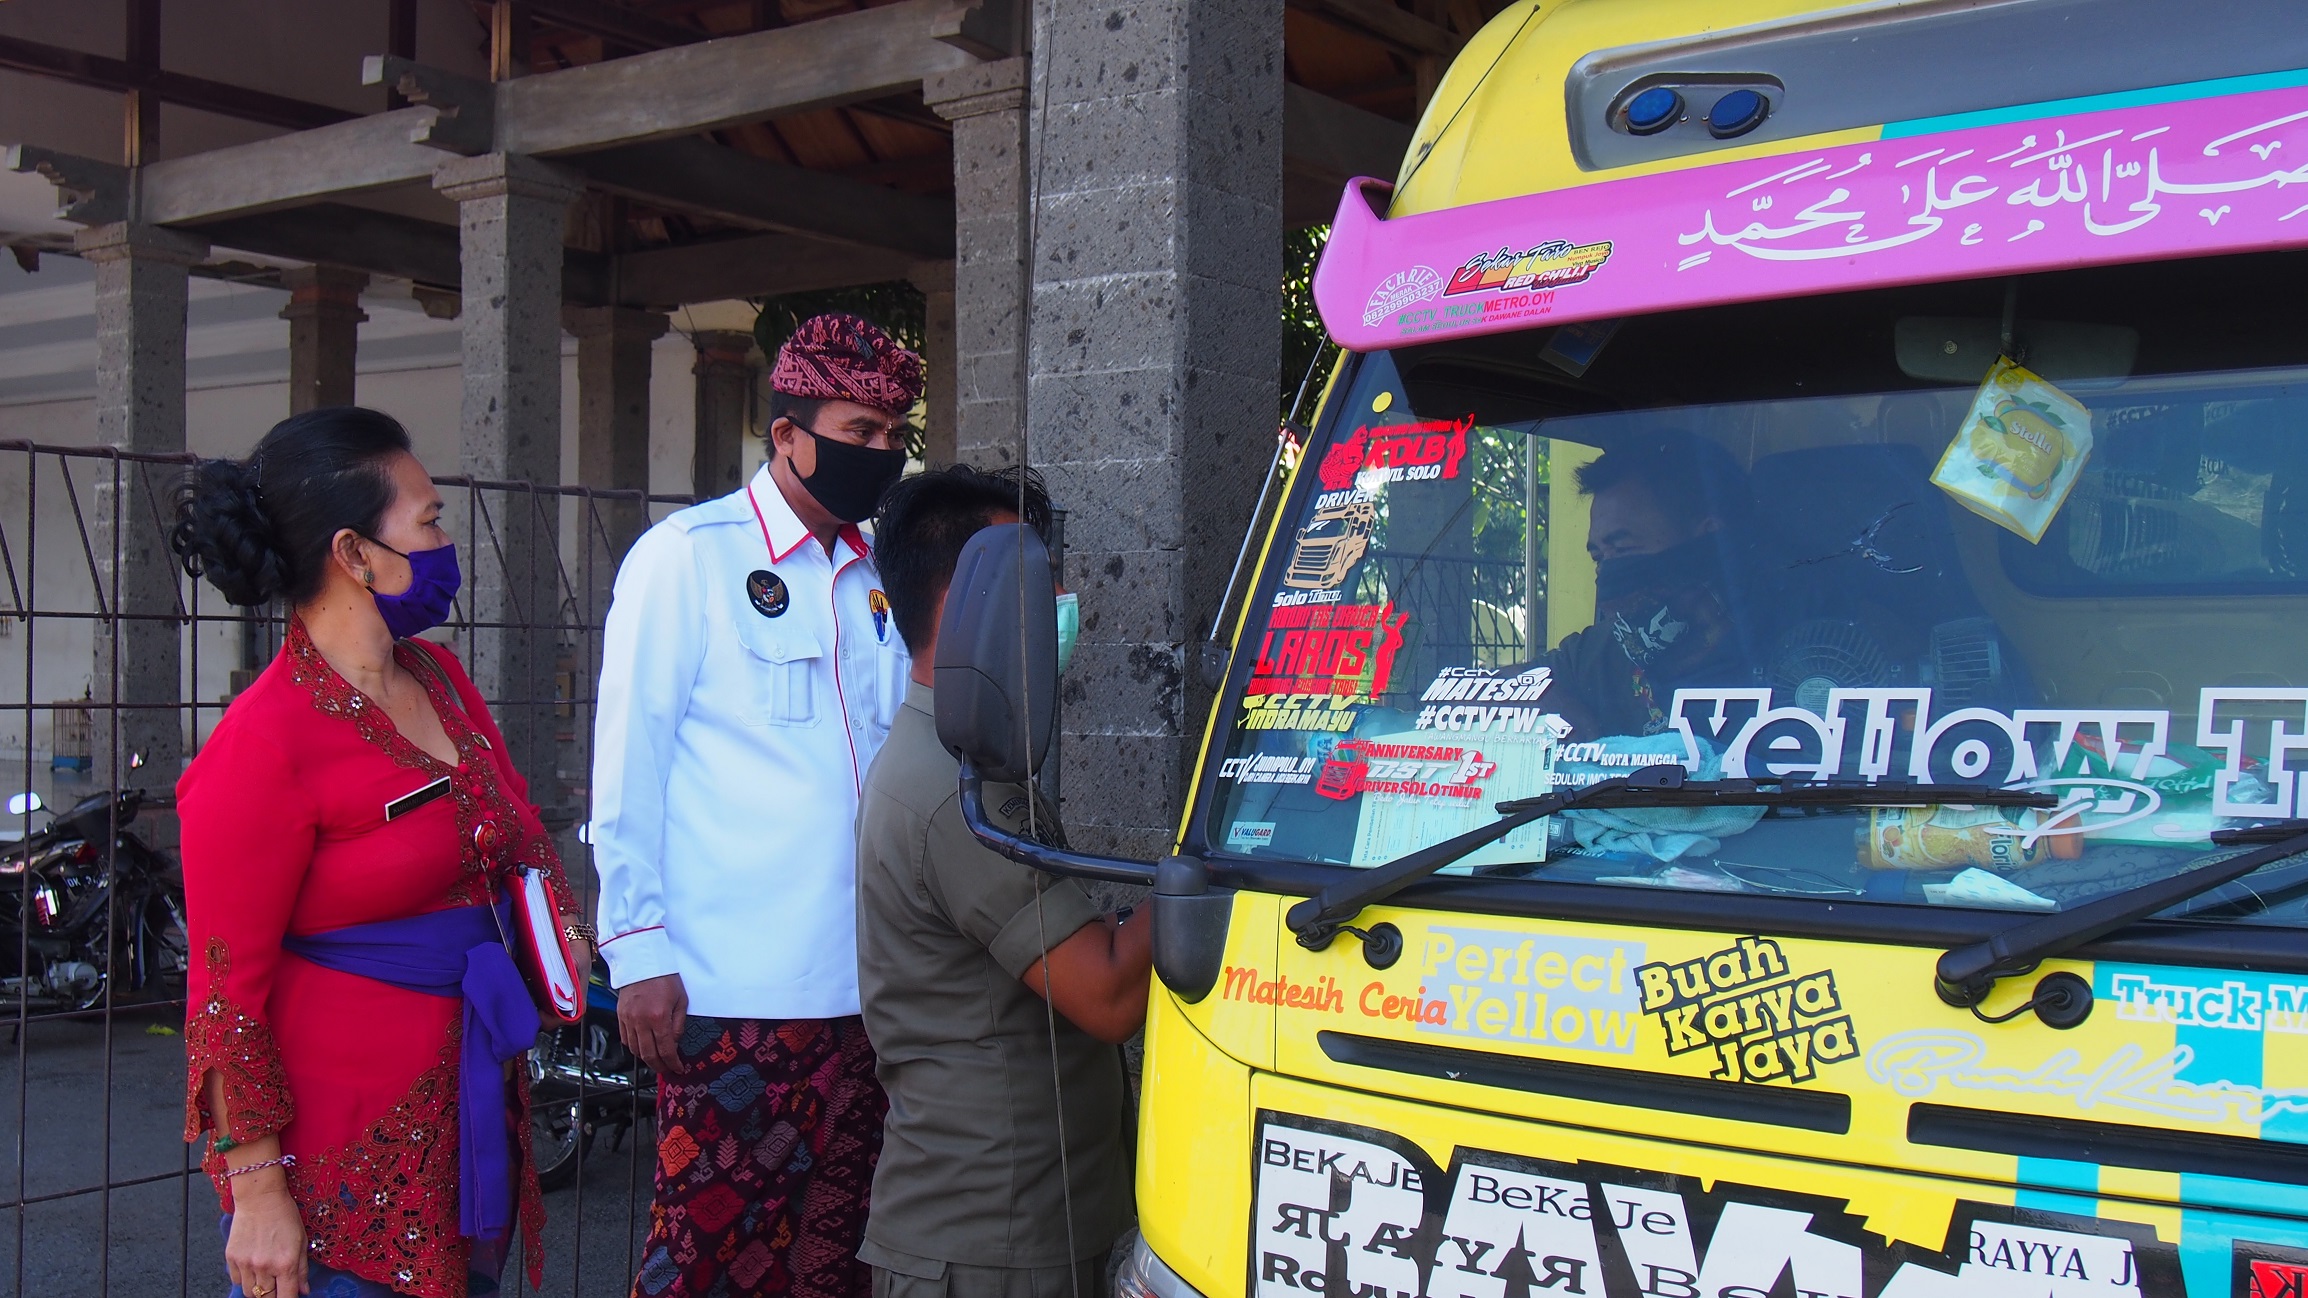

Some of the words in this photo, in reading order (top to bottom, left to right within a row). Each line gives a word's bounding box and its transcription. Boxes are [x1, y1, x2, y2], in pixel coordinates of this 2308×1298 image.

[1504, 273, 1537, 290] RED
[1537, 264, 1591, 282] CHILLI
[1398, 309, 1438, 326] #CCTV
[1488, 311, 1522, 323] DAWANE
[1523, 306, 1552, 319] DALAN
[1364, 435, 1447, 467] KDLB
[2009, 420, 2053, 455] Stella
[1406, 464, 1442, 481] SOLO
[1315, 489, 1377, 510] DRIVER
[1272, 590, 1308, 607] Solo
[1254, 630, 1374, 676] LAROS
[1264, 693, 1357, 711] CCTV
[1245, 709, 1358, 732] INDRAMAYU
[1365, 744, 1463, 761] ANNIVERSARY
[1554, 743, 1607, 762] #CCTV
[1600, 753, 1629, 766] KOTA
[1630, 753, 1677, 766] MANGGA
[1543, 773, 1586, 786] SEDULUR
[1424, 931, 1627, 994] Perfect
[1636, 936, 1787, 1013] Buah
[1223, 966, 1344, 1013] Matesih
[1359, 981, 1448, 1026] Ceria
[2112, 974, 2262, 1031] Truck
[1448, 984, 1638, 1049] Yellow
[1662, 972, 1839, 1054] Karya
[1711, 1018, 1857, 1083] Jaya
[1969, 1229, 2090, 1281] RAYYA
